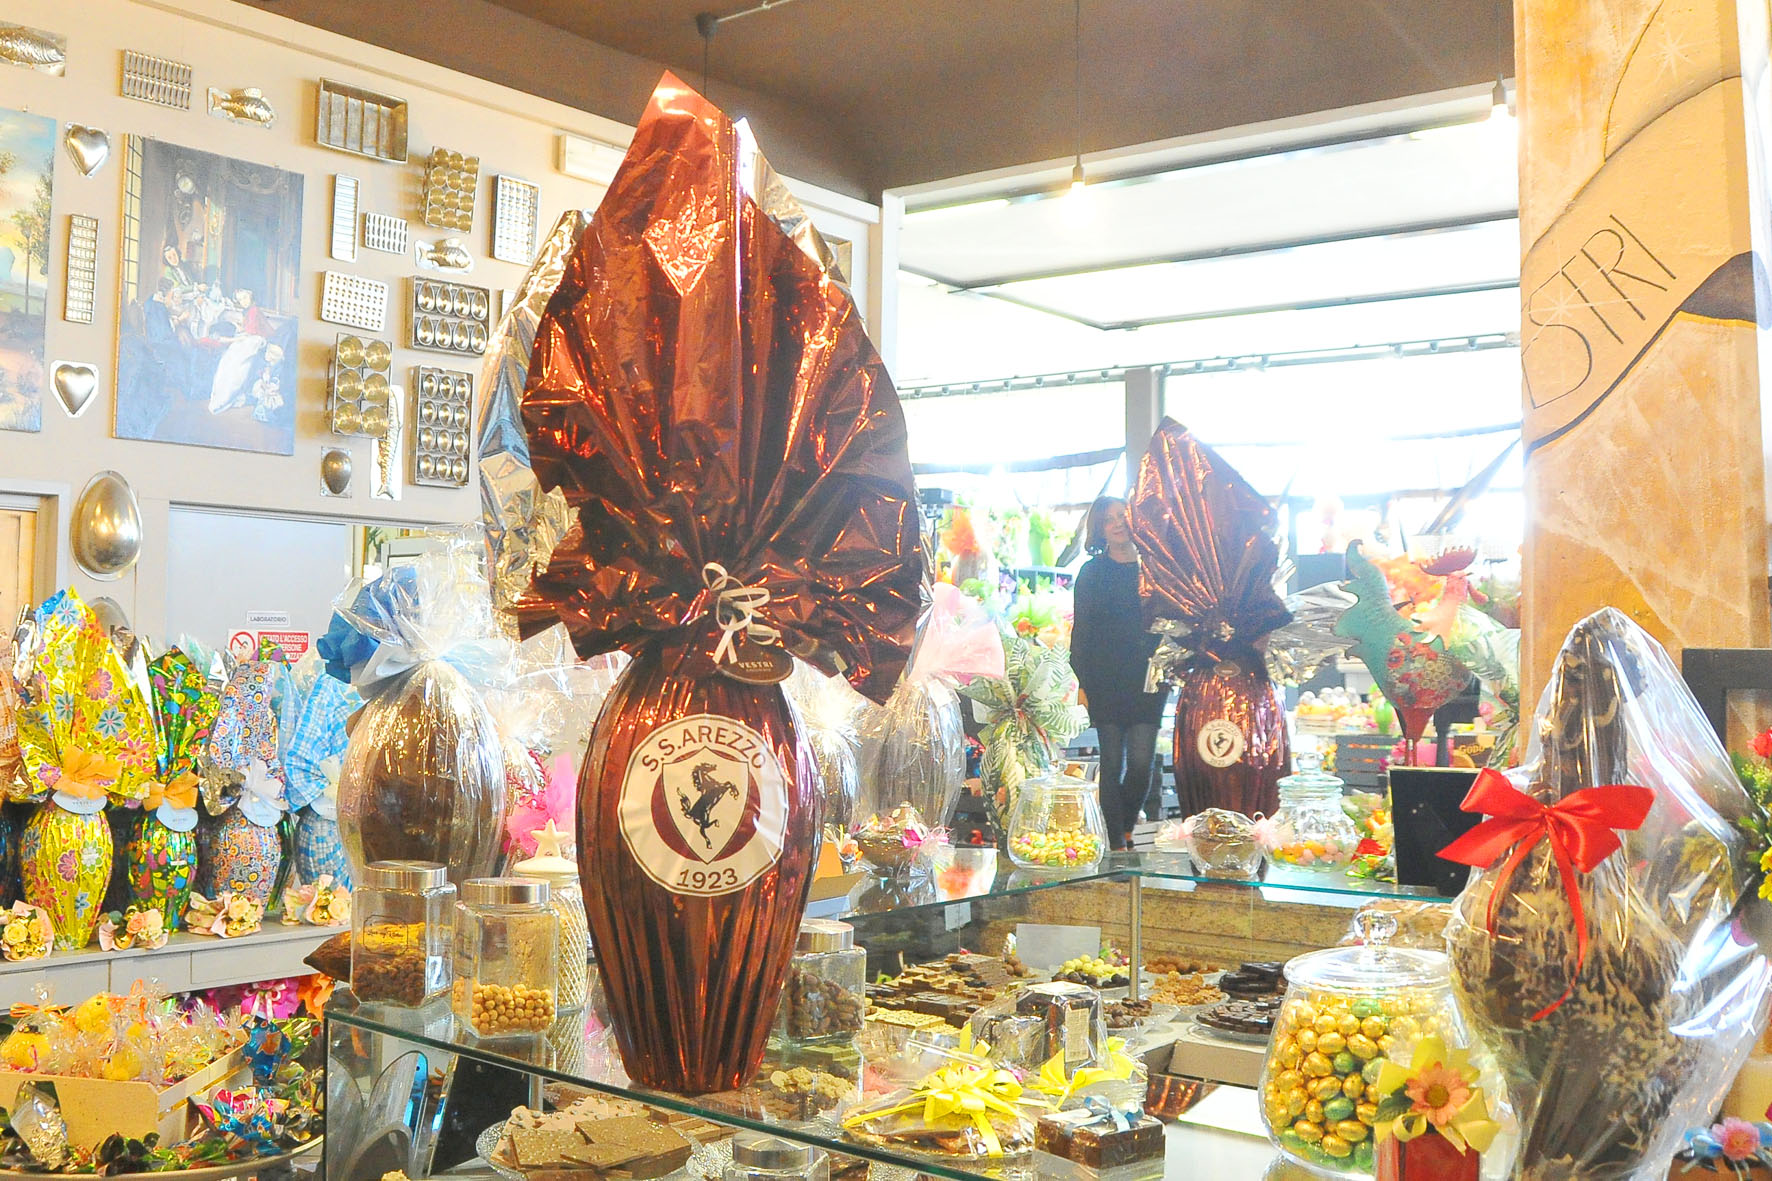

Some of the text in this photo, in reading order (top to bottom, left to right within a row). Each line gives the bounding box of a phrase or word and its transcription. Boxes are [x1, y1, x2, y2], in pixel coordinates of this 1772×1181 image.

[1521, 214, 1677, 409] STRI
[279, 635, 307, 643] L'ACCESSO
[281, 643, 302, 652] ERSONE
[737, 661, 774, 669] VESTRI
[676, 868, 738, 890] 1923
